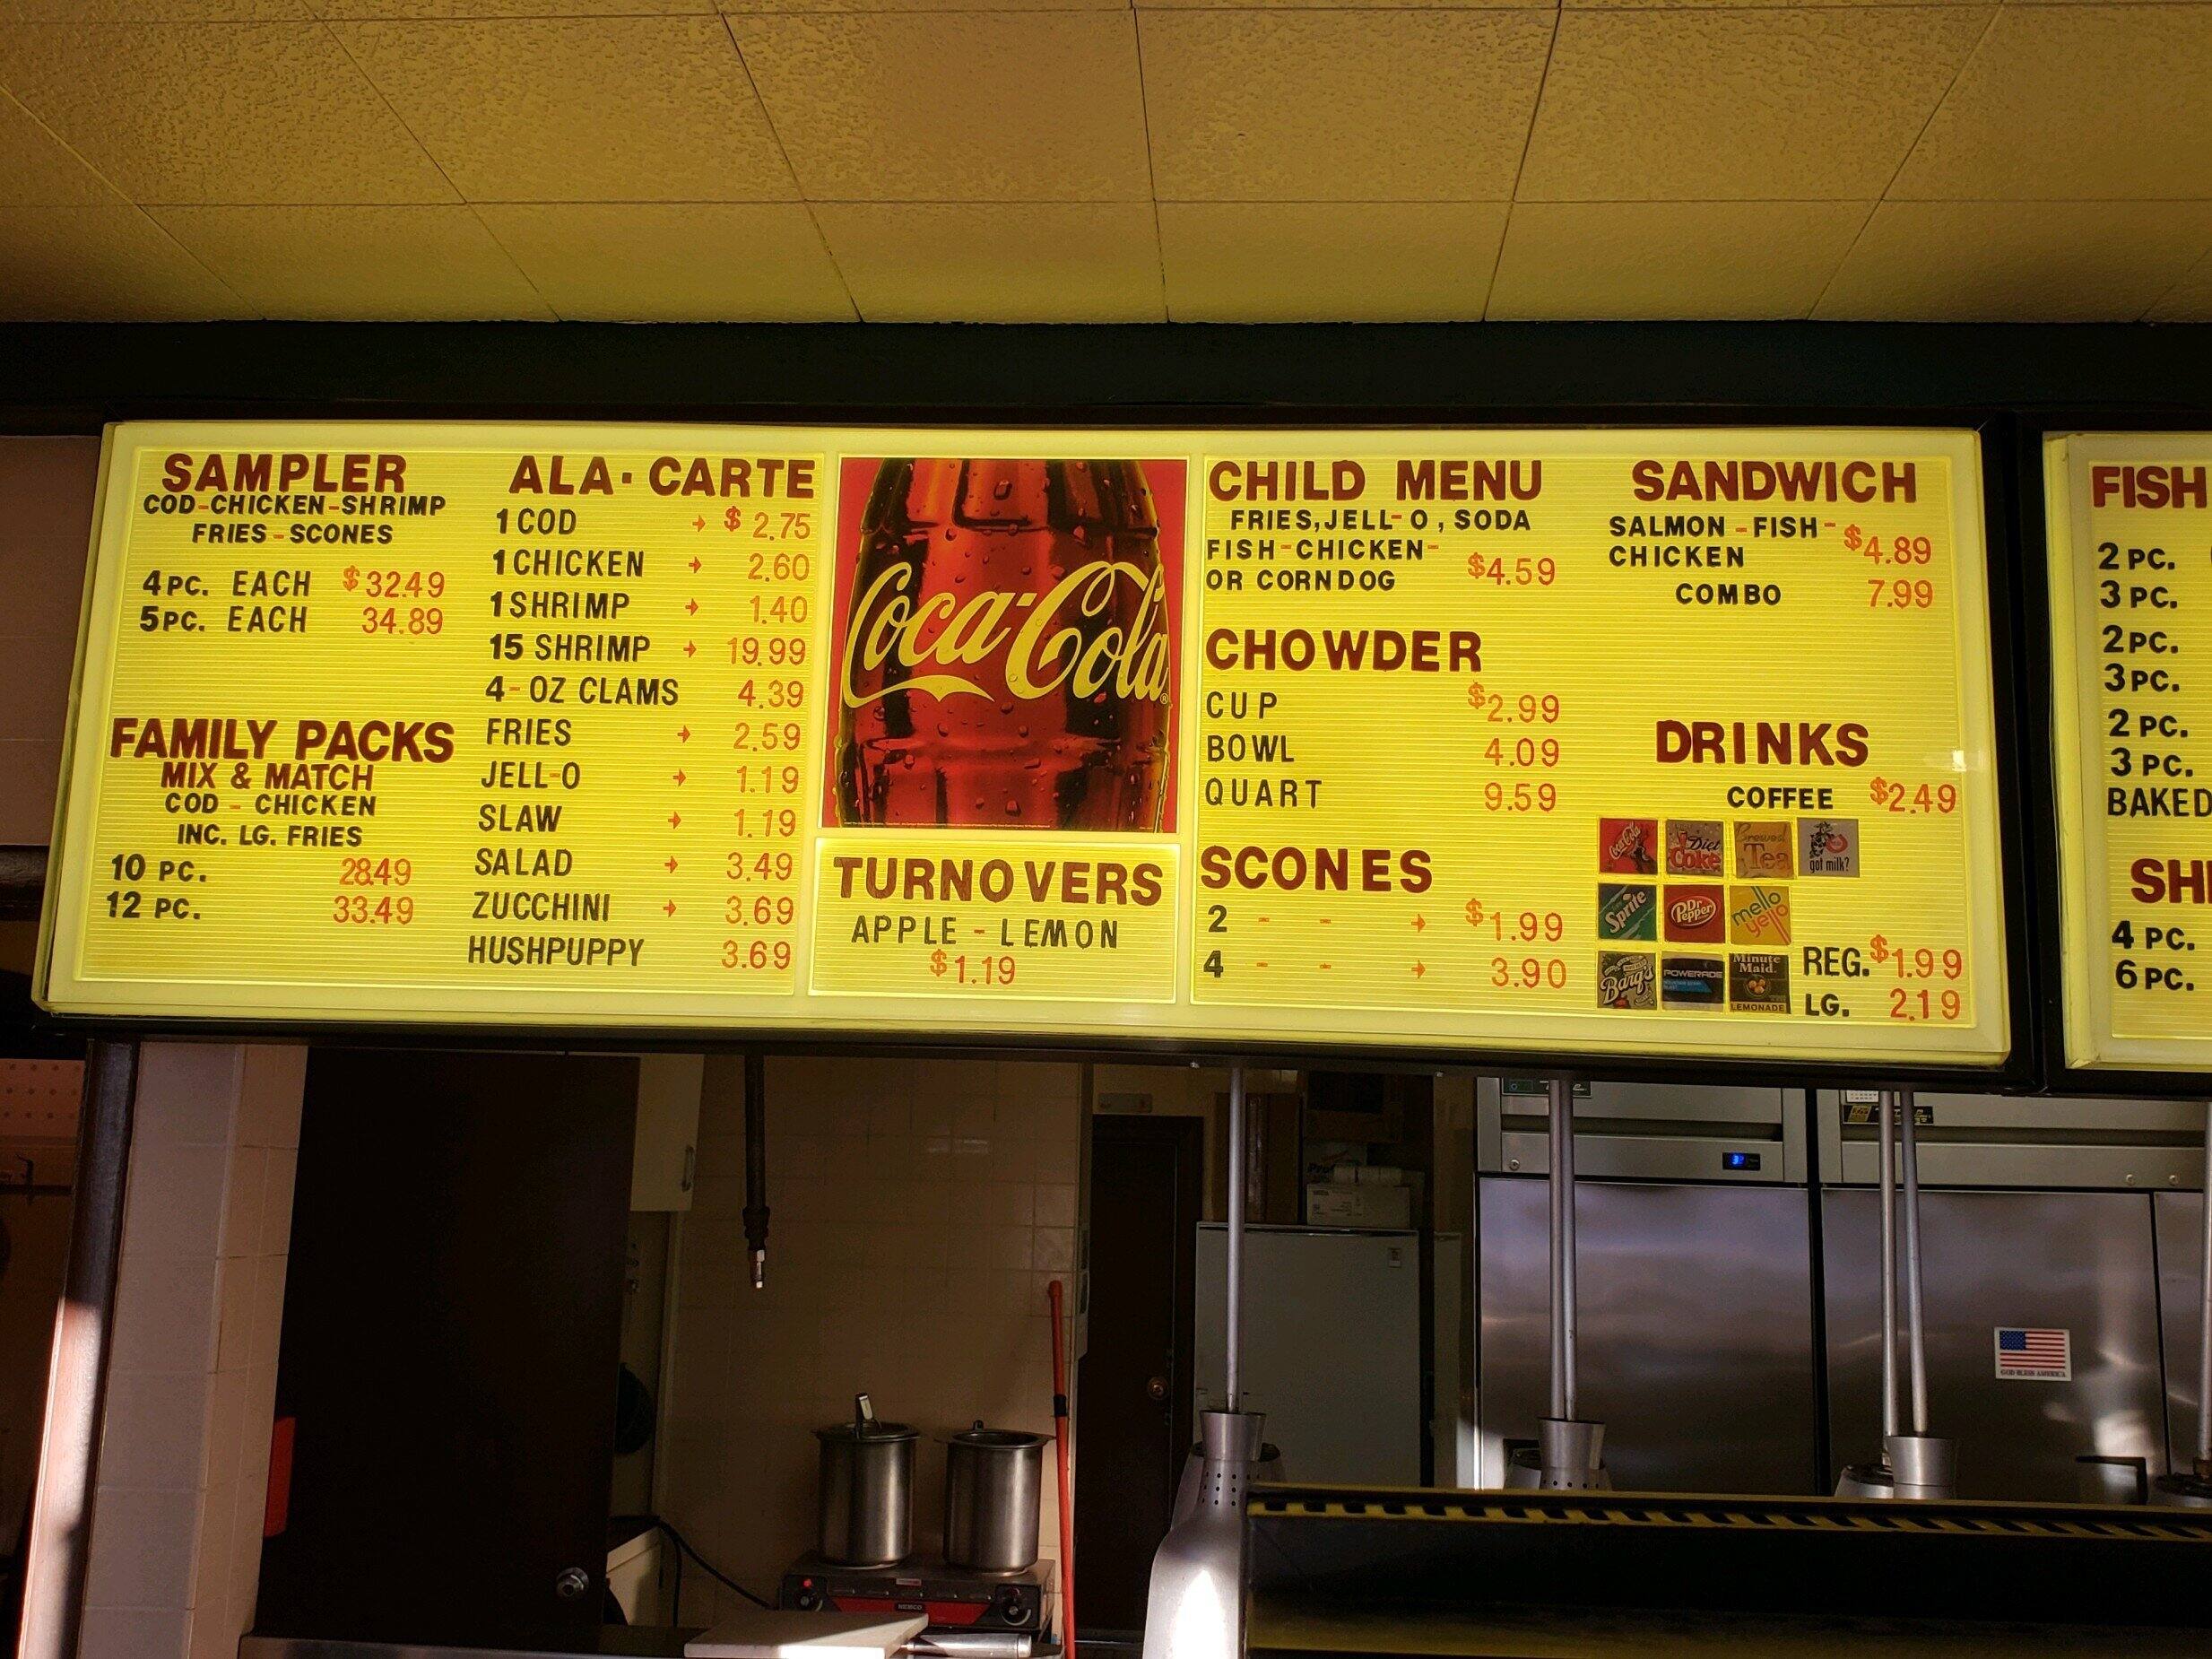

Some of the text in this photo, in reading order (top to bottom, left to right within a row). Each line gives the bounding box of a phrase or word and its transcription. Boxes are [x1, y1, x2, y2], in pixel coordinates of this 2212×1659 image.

[162, 454, 406, 492] SAMPLER
[1210, 460, 1542, 501] CHILD MENU
[1632, 459, 1916, 503] SANDWICH
[2092, 466, 2207, 508] FISH
[1453, 509, 1531, 531] SODA
[1609, 524, 1931, 568] CHICKEN $4.89
[2098, 542, 2175, 570] 2 PC.
[232, 570, 311, 597] EACH
[748, 552, 810, 582] 2.60
[1205, 569, 1243, 591] OR
[1467, 552, 1556, 586] $4.59
[750, 595, 808, 624] 1.40
[1675, 578, 1934, 609] COMBO 7.99
[228, 605, 308, 633] EACH
[362, 607, 443, 635] 34.89
[842, 560, 1170, 708] Coca-Cola
[490, 633, 806, 666] 15 SHRIMP 19.99
[1206, 629, 1481, 673] CHOWDER
[578, 676, 679, 706] CLAMS
[737, 679, 804, 709] 4.39
[1207, 681, 1560, 724] CUP $2.99
[110, 717, 455, 764] FAMILY PACKS
[486, 717, 801, 752] FRIES 2.59
[1207, 734, 1560, 769] BOWL 4.09
[1656, 719, 1869, 768] DRINKS
[160, 761, 374, 791] MIX & MATCH
[481, 761, 800, 795] JELL-O 1.19
[165, 793, 219, 813] COD
[255, 794, 376, 816] CHICKEN
[1205, 777, 1557, 812] QUART 9.59
[1727, 776, 1956, 814] COFFEE $2.49
[2107, 787, 2212, 818] BAKED
[178, 823, 362, 847] INC. LG. FRIES
[478, 803, 796, 838] SLAW 1.19
[1670, 848, 1722, 870] Coke
[1685, 837, 1722, 851] Diet
[1744, 843, 1791, 871] Tea
[111, 854, 145, 882] 10
[159, 860, 206, 882] PC.
[474, 847, 793, 882] SALAD 3.49
[833, 856, 1163, 907] TURNOVERS
[1201, 845, 1433, 893] SCONES
[1809, 856, 1850, 873] got milk?
[2130, 858, 2212, 904] SH
[107, 890, 413, 925] 12 PC. 33.49
[472, 891, 794, 926] ZUCCHINI 3.69
[1207, 905, 1227, 933] 2
[1605, 890, 1647, 934] Sprite
[1671, 901, 1713, 924] Pepper
[1687, 899, 1703, 910] Dr
[1731, 886, 1782, 926] mello
[851, 915, 957, 945] APPLE
[1001, 917, 1118, 950] LEMON
[1745, 903, 1791, 944] yello
[467, 934, 791, 970] HUSHPUPPY 3.69
[930, 948, 1016, 986] $1.19
[1203, 950, 1566, 989] 4 3.90
[1733, 953, 1781, 964] Minute
[1803, 934, 1963, 979] REG. $1.99
[1663, 968, 1723, 978] POWERADE
[1731, 1003, 1785, 1012] LEMONADE
[1805, 987, 1961, 1021] LG. 2.19
